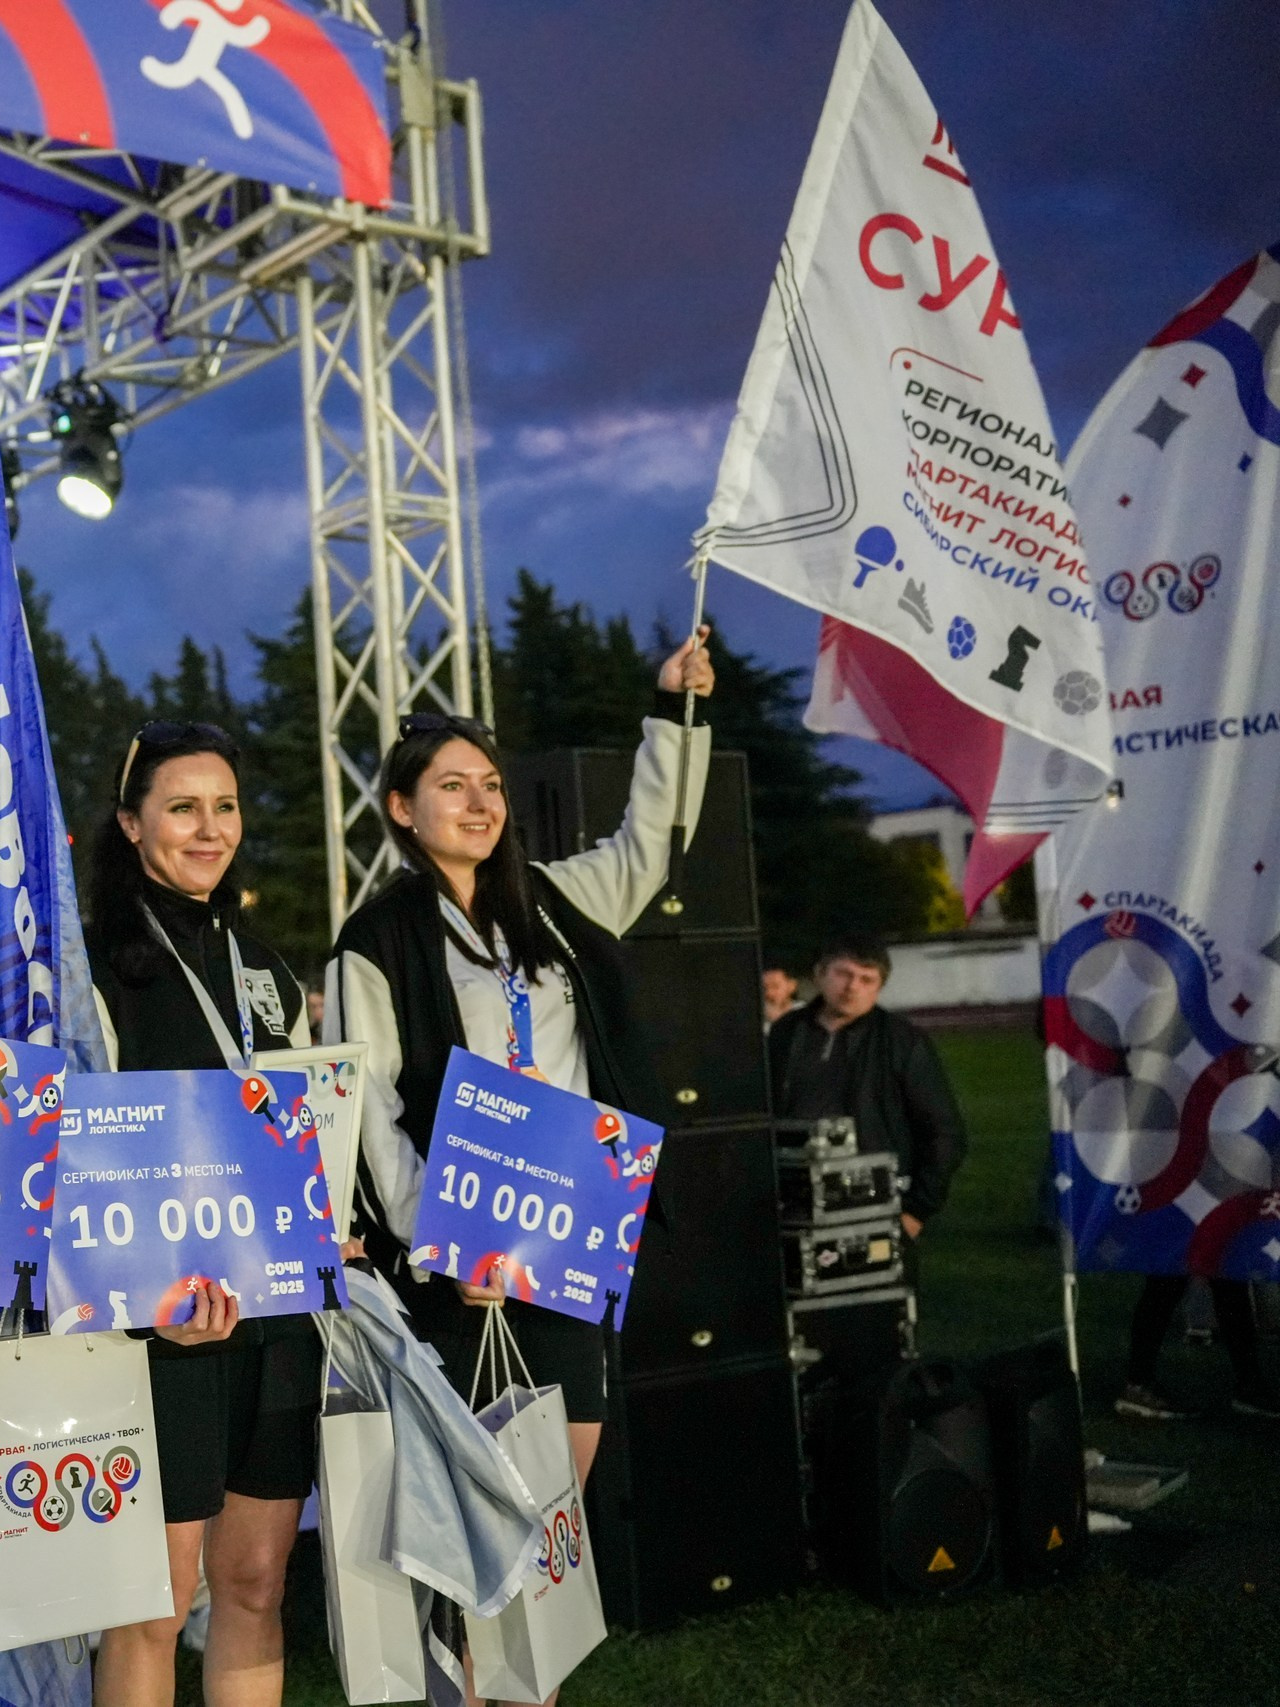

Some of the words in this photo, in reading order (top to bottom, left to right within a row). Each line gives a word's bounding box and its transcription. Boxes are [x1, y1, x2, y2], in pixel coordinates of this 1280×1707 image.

[906, 461, 986, 534] МНИТ
[1047, 586, 1098, 622] ОК
[87, 1105, 166, 1124] МАГНИТ
[474, 1104, 511, 1124] ЛОГИСТИКА
[476, 1089, 531, 1120] МАГНИТ
[89, 1124, 146, 1135] ЛОГИСТИКА
[446, 1134, 503, 1163] СЕРТИФИКАТ
[502, 1155, 515, 1168] ЗА
[515, 1157, 525, 1171] 3
[525, 1163, 558, 1183] МЕСТО
[559, 1175, 575, 1189] НА
[62, 1168, 150, 1184] СЕРТИФИКАТ
[153, 1167, 169, 1178] ЗА
[171, 1163, 182, 1178] 3
[184, 1164, 224, 1177] МЕСТО
[226, 1163, 243, 1175] НА
[439, 1164, 480, 1210] 10
[492, 1184, 574, 1241] 000
[69, 1202, 134, 1248] 10
[158, 1195, 256, 1242] 000
[265, 1261, 304, 1276] СОЧИ
[564, 1268, 598, 1289] СОЧИ
[270, 1281, 305, 1295] 2025
[563, 1284, 593, 1304] 2025
[33, 1432, 111, 1451] ЛОГИСТИЧЕСКАЯ
[117, 1427, 140, 1438] ТВОЯ
[3, 1526, 28, 1536] МАГНИТ
